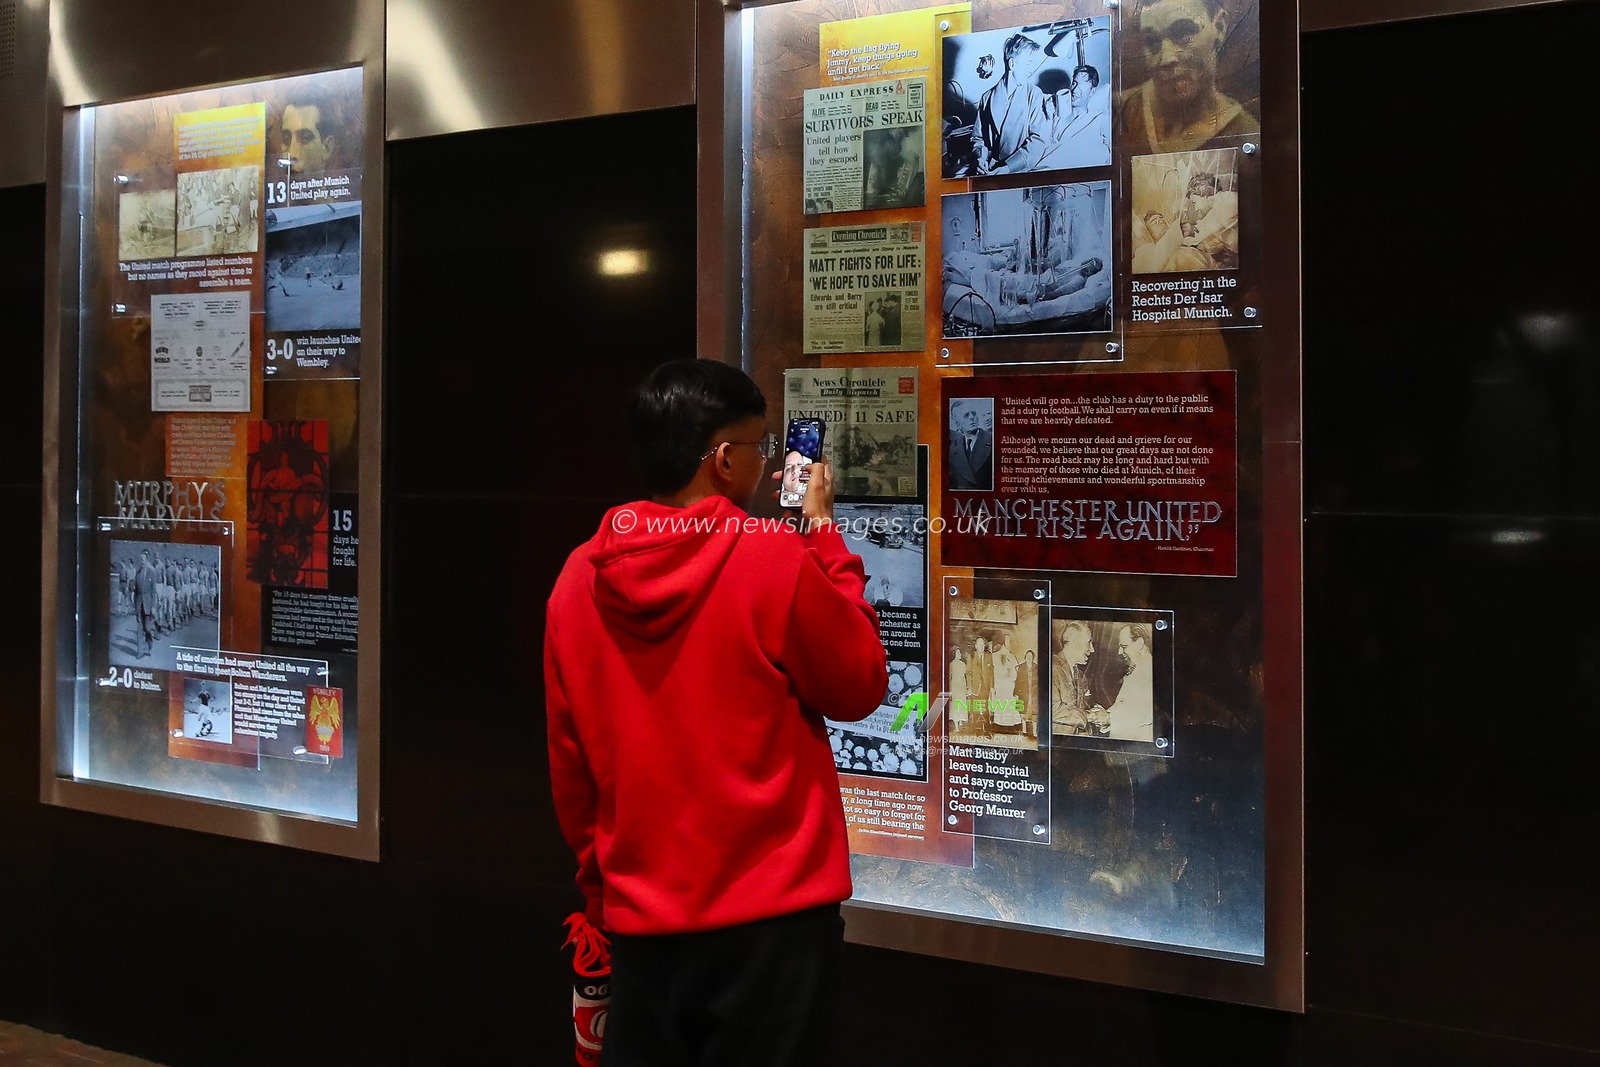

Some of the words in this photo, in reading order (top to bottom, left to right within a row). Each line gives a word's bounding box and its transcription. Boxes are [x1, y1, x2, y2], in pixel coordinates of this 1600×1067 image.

[879, 43, 900, 51] flying
[827, 58, 851, 68] Jimmy,
[853, 56, 871, 64] keep
[873, 52, 895, 60] things
[896, 50, 918, 58] going
[827, 67, 842, 76] until
[849, 66, 860, 75] get
[862, 62, 885, 71] back."
[820, 92, 844, 101] DAILY
[850, 86, 894, 98] EXPRESS
[812, 107, 826, 116] ALIVE
[866, 102, 878, 111] DEAD
[805, 115, 874, 133] SURVIVORS
[881, 110, 923, 125] SPEAK
[807, 135, 830, 146] United
[835, 133, 861, 144] players
[819, 147, 830, 155] tell
[834, 146, 848, 154] how
[810, 158, 825, 166] they
[829, 154, 858, 165] escaped
[290, 180, 306, 190] days
[307, 178, 323, 187] after
[324, 176, 349, 185] Munich
[268, 182, 286, 204] 13
[290, 189, 312, 199] United
[314, 188, 328, 199] play
[330, 187, 350, 198] again.
[832, 230, 856, 242] Evening
[858, 228, 887, 240] Chronicle
[810, 258, 836, 272] MATT
[840, 257, 871, 271] FIGHTS
[875, 256, 893, 269] FOR
[810, 277, 827, 290] 'WE
[830, 276, 853, 289] HOPE
[857, 275, 869, 288] TO
[872, 274, 896, 287] SAVE
[900, 272, 921, 286] HIM'
[1132, 278, 1200, 292] Recovering
[1202, 277, 1214, 288] in
[1217, 276, 1236, 287] the
[1132, 294, 1171, 306] Rechts
[1174, 293, 1197, 305] Der
[1200, 292, 1223, 303] Isar
[1132, 308, 1181, 323] Hospital
[1184, 306, 1233, 318] Munich.
[296, 336, 309, 344] win
[310, 336, 340, 344] launches
[267, 338, 293, 360] 3-0
[306, 347, 322, 355] their
[323, 348, 337, 356] way
[296, 357, 329, 368] Wembley.
[813, 377, 836, 387] News
[840, 376, 886, 387] Chronicle
[1048, 398, 1058, 406] go
[1134, 395, 1153, 404] duty
[1180, 394, 1208, 404] public
[788, 410, 847, 422] UNITED:
[855, 411, 867, 422] 11
[875, 410, 914, 422] SAFE
[1022, 407, 1039, 416] duty
[1096, 405, 1114, 413] shall
[1172, 404, 1178, 412] if
[1178, 404, 1184, 412] it
[1044, 416, 1073, 425] heavily
[1074, 415, 1113, 424] defeated.
[1001, 436, 1036, 445] Although
[1134, 436, 1161, 445] grieve
[1164, 435, 1176, 443] for
[115, 480, 227, 509] MURPHY'S
[119, 502, 222, 532] MARVELS
[953, 498, 1120, 521] MANCHESTER
[1126, 500, 1222, 523] UNITED
[333, 510, 352, 531] 15
[970, 516, 1028, 537] WILL
[333, 535, 349, 546] days
[351, 535, 359, 544] he
[333, 546, 354, 557] fought
[333, 557, 342, 565] for
[344, 557, 356, 566] life.
[109, 666, 133, 689] 2-0
[134, 670, 153, 680] defeat
[140, 681, 161, 690] Bolton.
[949, 745, 973, 758] Matt
[975, 747, 1008, 763] Busby
[949, 759, 983, 772] leaves
[986, 761, 1029, 778] hospital
[949, 774, 970, 785] and
[972, 777, 994, 789] says
[997, 778, 1044, 793] goodbye
[854, 787, 865, 795] the
[881, 791, 903, 799] match
[949, 788, 959, 798] to
[961, 788, 1013, 804] Professor
[949, 800, 984, 816] Georg
[986, 803, 1026, 819] Maurer
